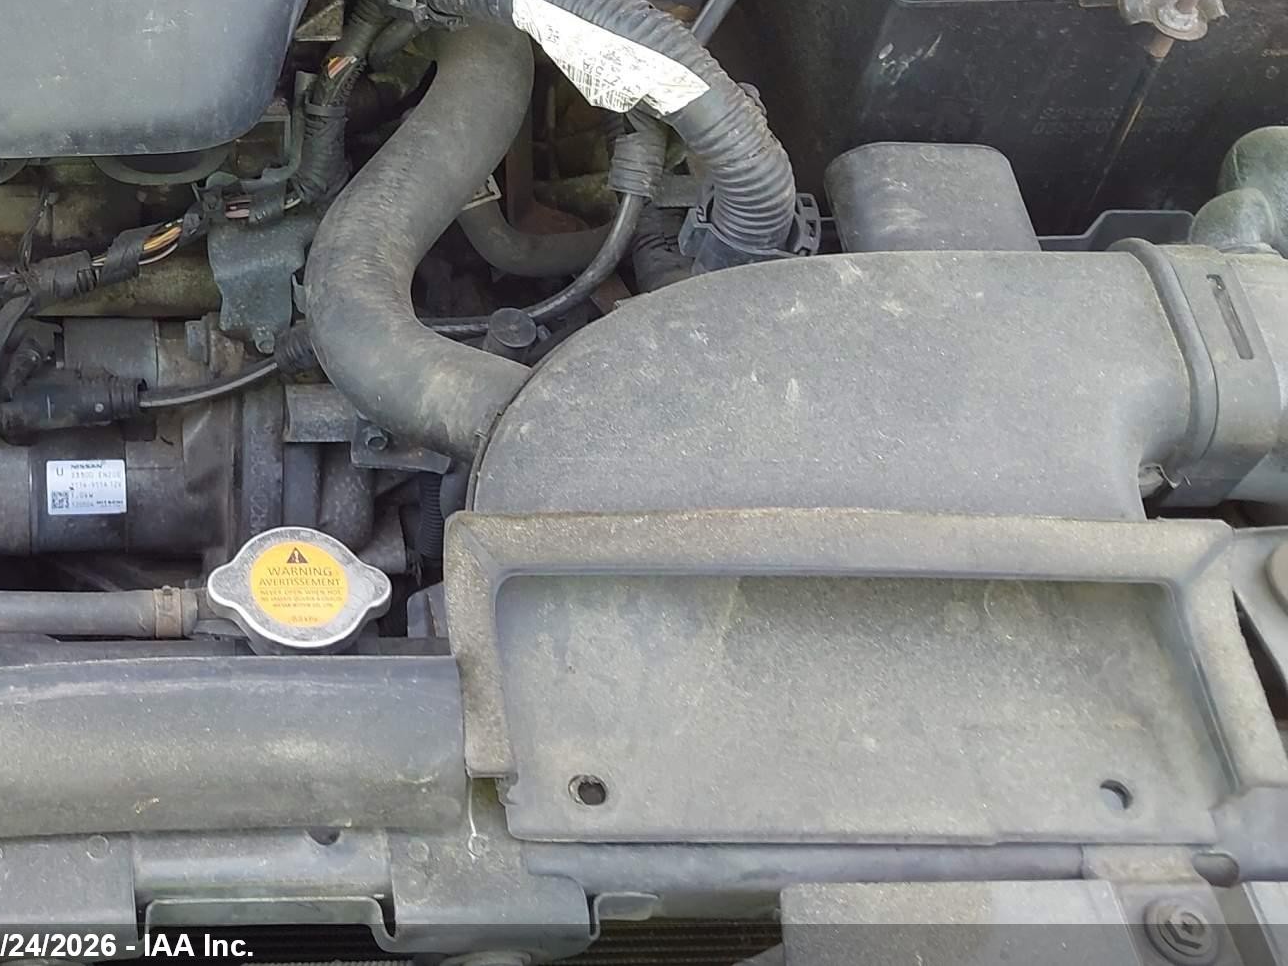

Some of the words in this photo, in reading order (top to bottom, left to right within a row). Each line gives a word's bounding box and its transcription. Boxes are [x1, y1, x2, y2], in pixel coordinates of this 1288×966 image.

[56, 466, 64, 477] U
[268, 566, 333, 577] WARNING
[259, 577, 341, 586] AVERTISSEMENT
